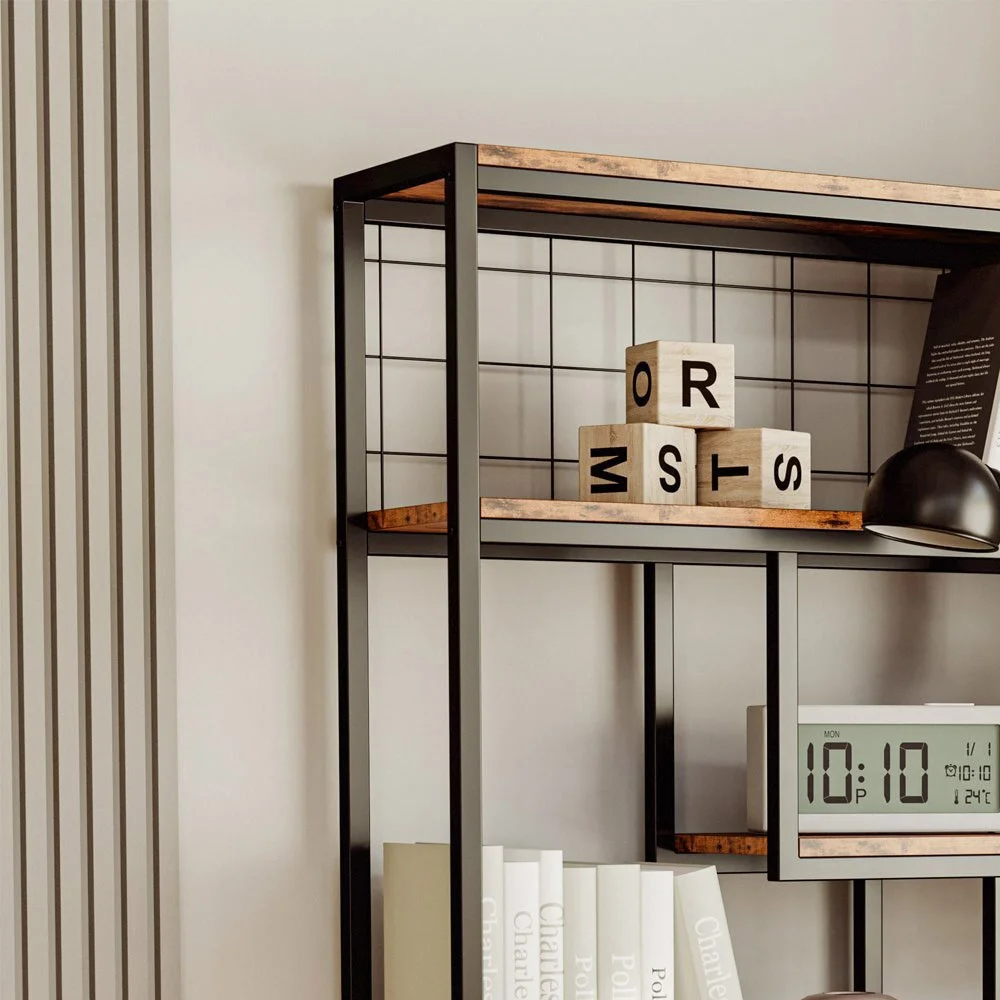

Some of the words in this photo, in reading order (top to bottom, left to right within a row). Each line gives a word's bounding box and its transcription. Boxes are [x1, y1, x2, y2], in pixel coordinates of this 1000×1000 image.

[632, 361, 651, 407] O
[682, 360, 720, 409] R
[590, 446, 628, 493] M
[658, 444, 682, 493] S
[711, 454, 749, 491] T
[774, 453, 802, 491] S
[824, 730, 840, 738] MON
[958, 765, 991, 781] 10:10
[855, 788, 867, 804] P
